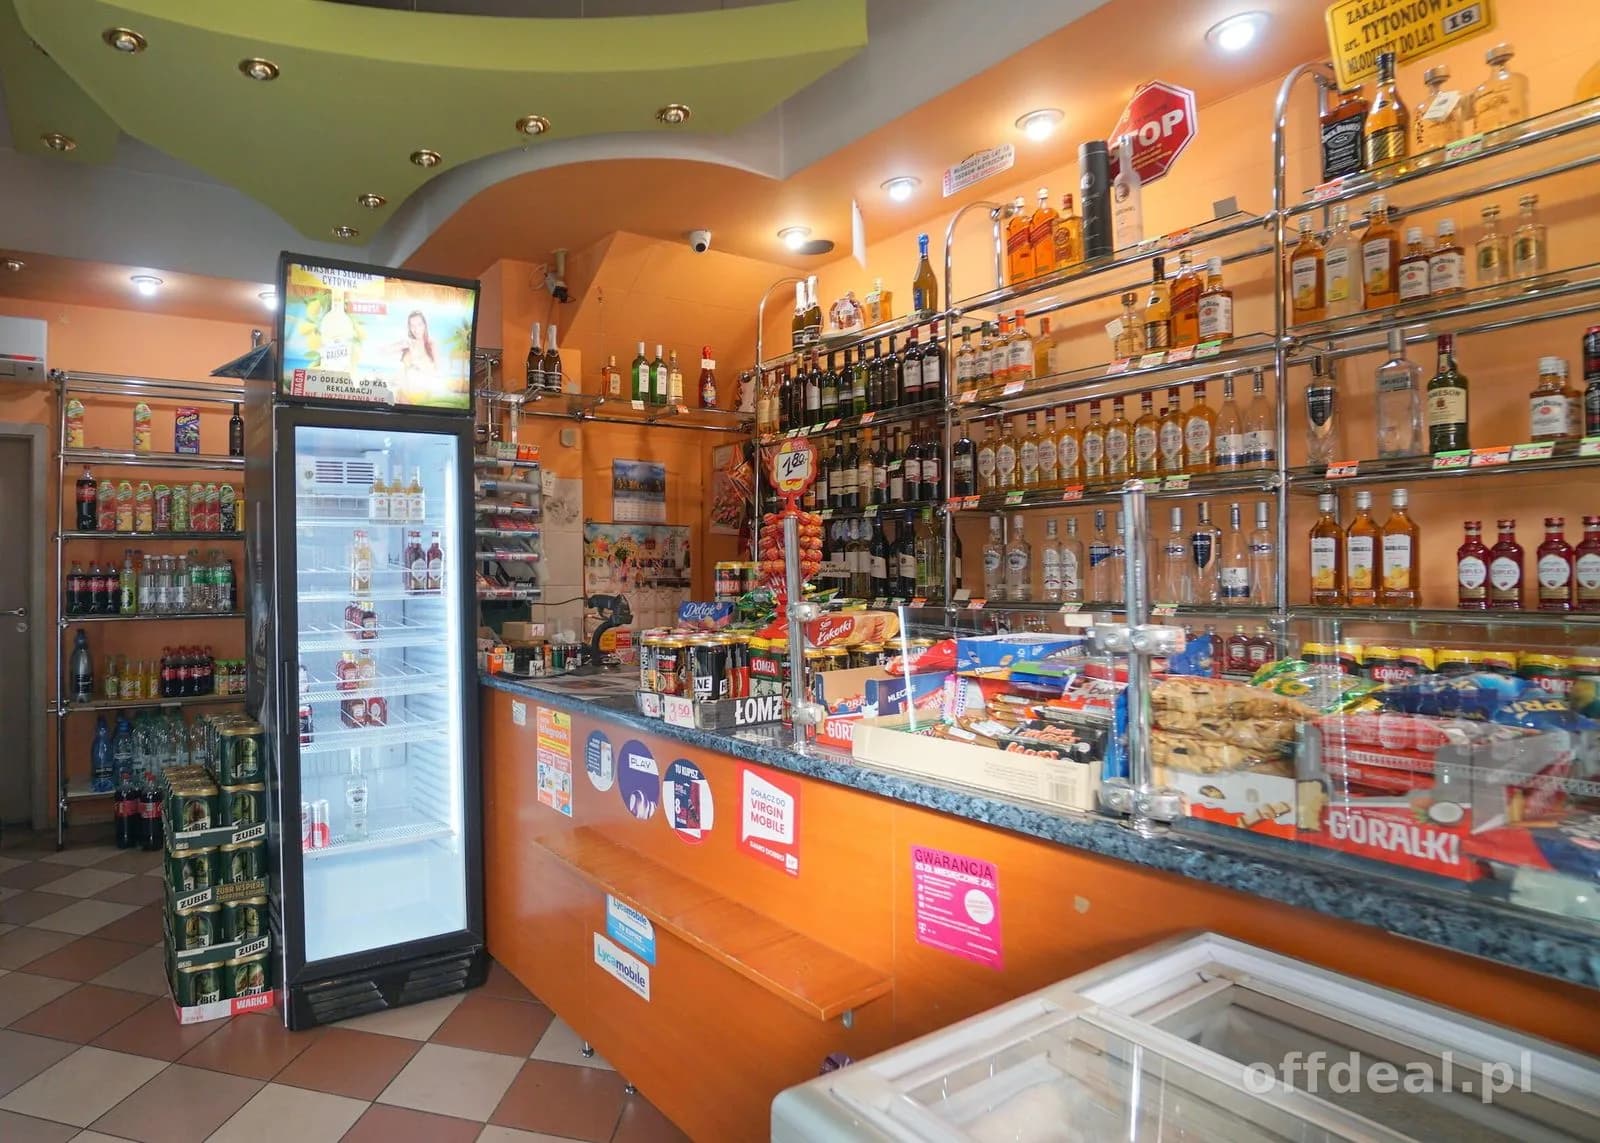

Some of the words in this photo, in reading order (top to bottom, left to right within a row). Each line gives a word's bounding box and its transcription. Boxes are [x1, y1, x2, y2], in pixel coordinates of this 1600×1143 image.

[1401, 32, 1415, 54] DO
[1416, 22, 1436, 48] LAT
[1448, 9, 1475, 31] 18
[326, 385, 373, 395] REKLAMACJI
[631, 757, 651, 769] PLAY
[751, 798, 784, 820] VIRGIN
[750, 812, 785, 835] MOBILE
[914, 849, 993, 880] GWARANCJA
[597, 944, 646, 988] Lycamobile
[236, 996, 268, 1011] WARKA
